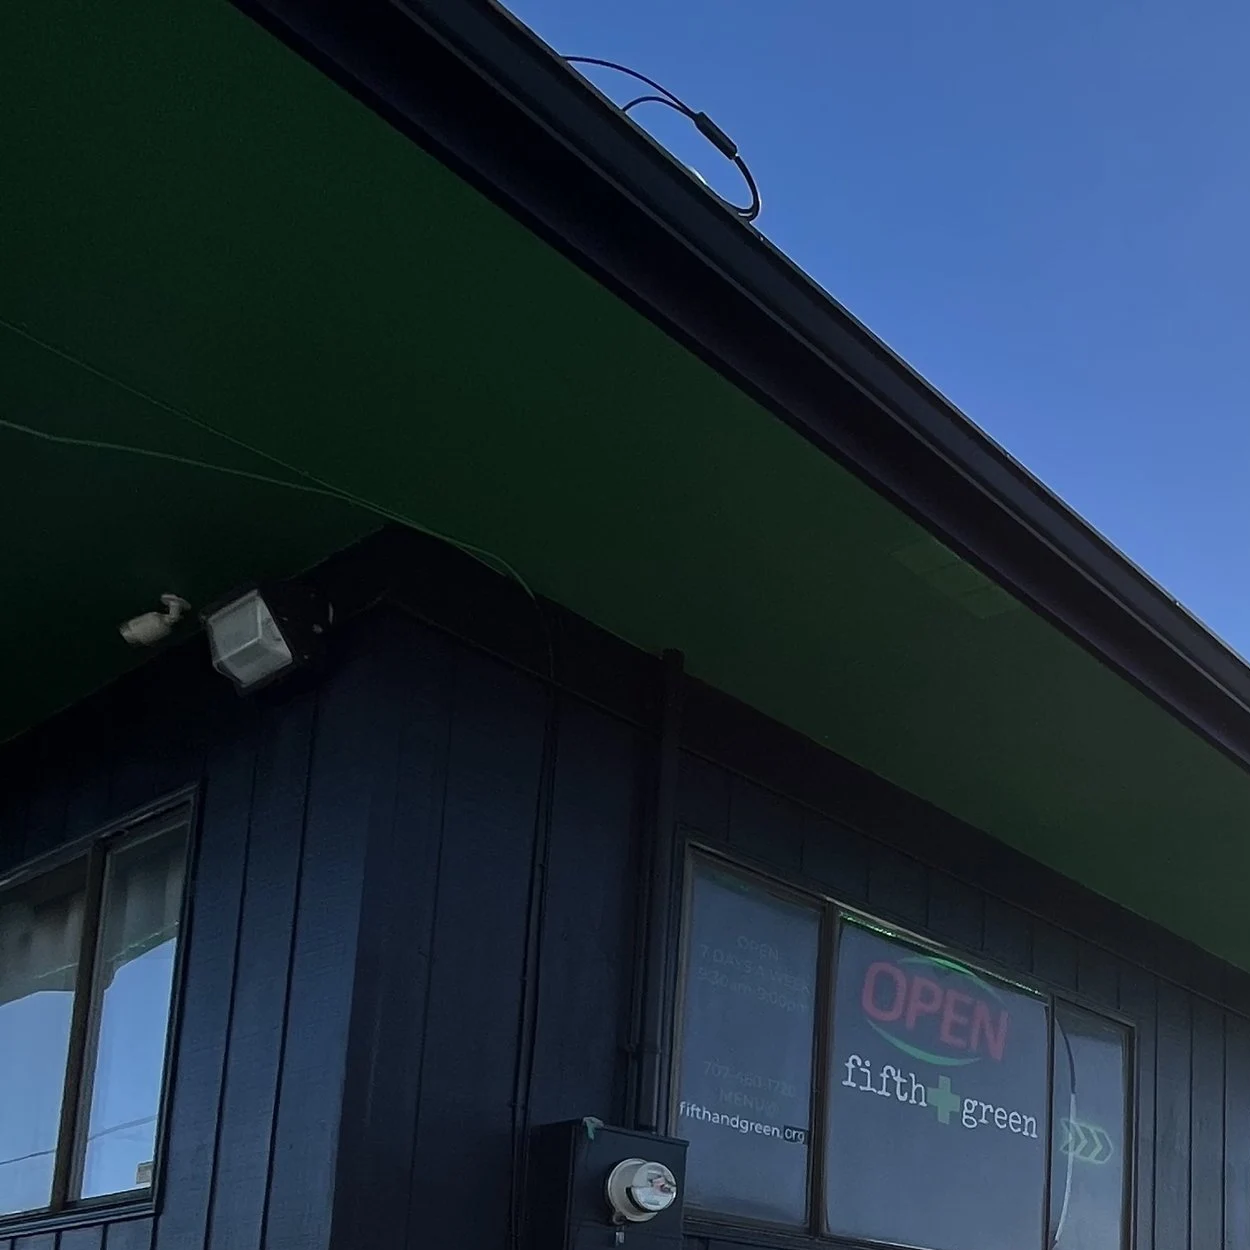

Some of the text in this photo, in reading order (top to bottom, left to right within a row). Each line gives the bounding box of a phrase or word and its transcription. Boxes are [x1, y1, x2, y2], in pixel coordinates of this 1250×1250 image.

[862, 962, 1009, 1061] OPEN
[679, 1100, 805, 1143] fifthandgreen.org
[842, 1054, 1038, 1138] fifth green
